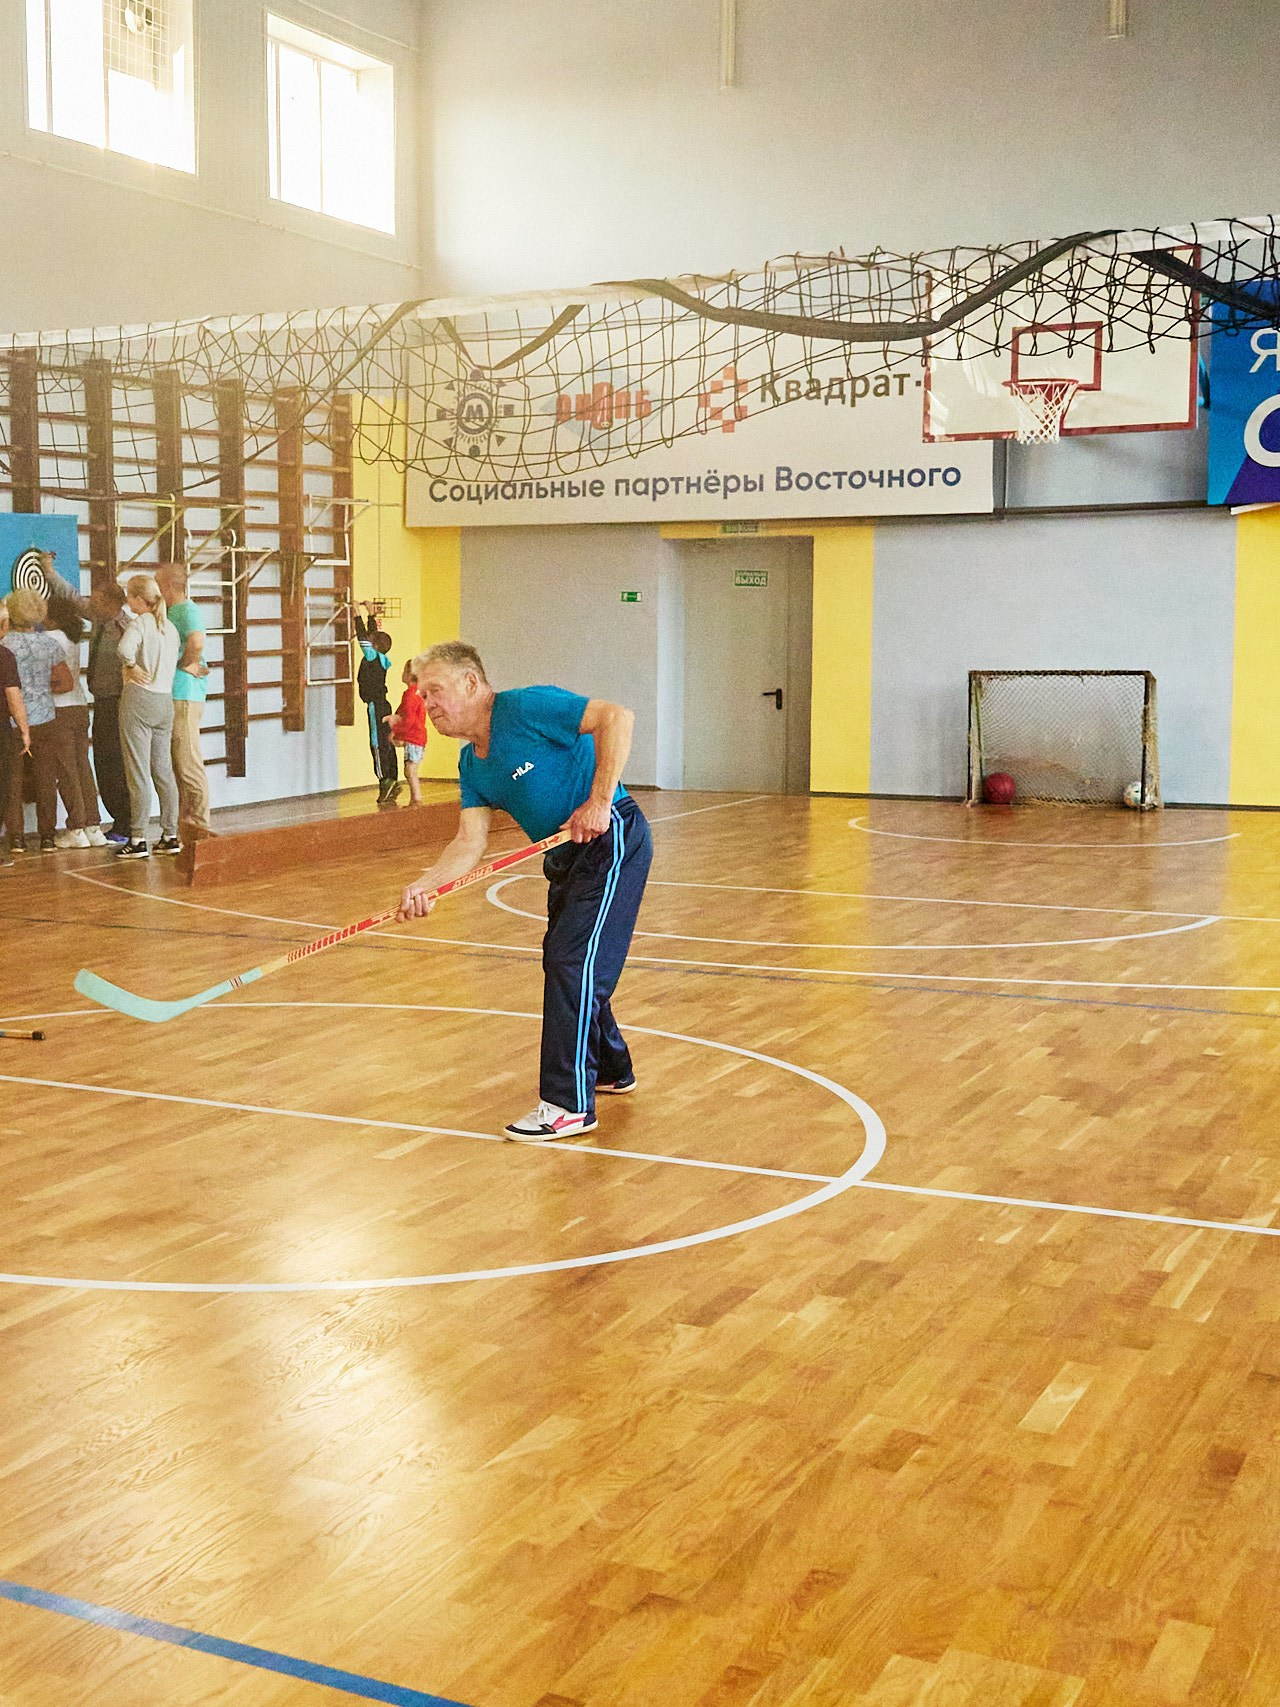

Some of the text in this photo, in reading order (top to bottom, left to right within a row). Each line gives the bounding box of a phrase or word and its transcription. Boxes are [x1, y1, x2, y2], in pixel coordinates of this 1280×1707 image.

[428, 465, 962, 505] Социальные партнёры Восточного
[735, 576, 768, 587] ВЫХОД
[511, 761, 535, 781] FILA
